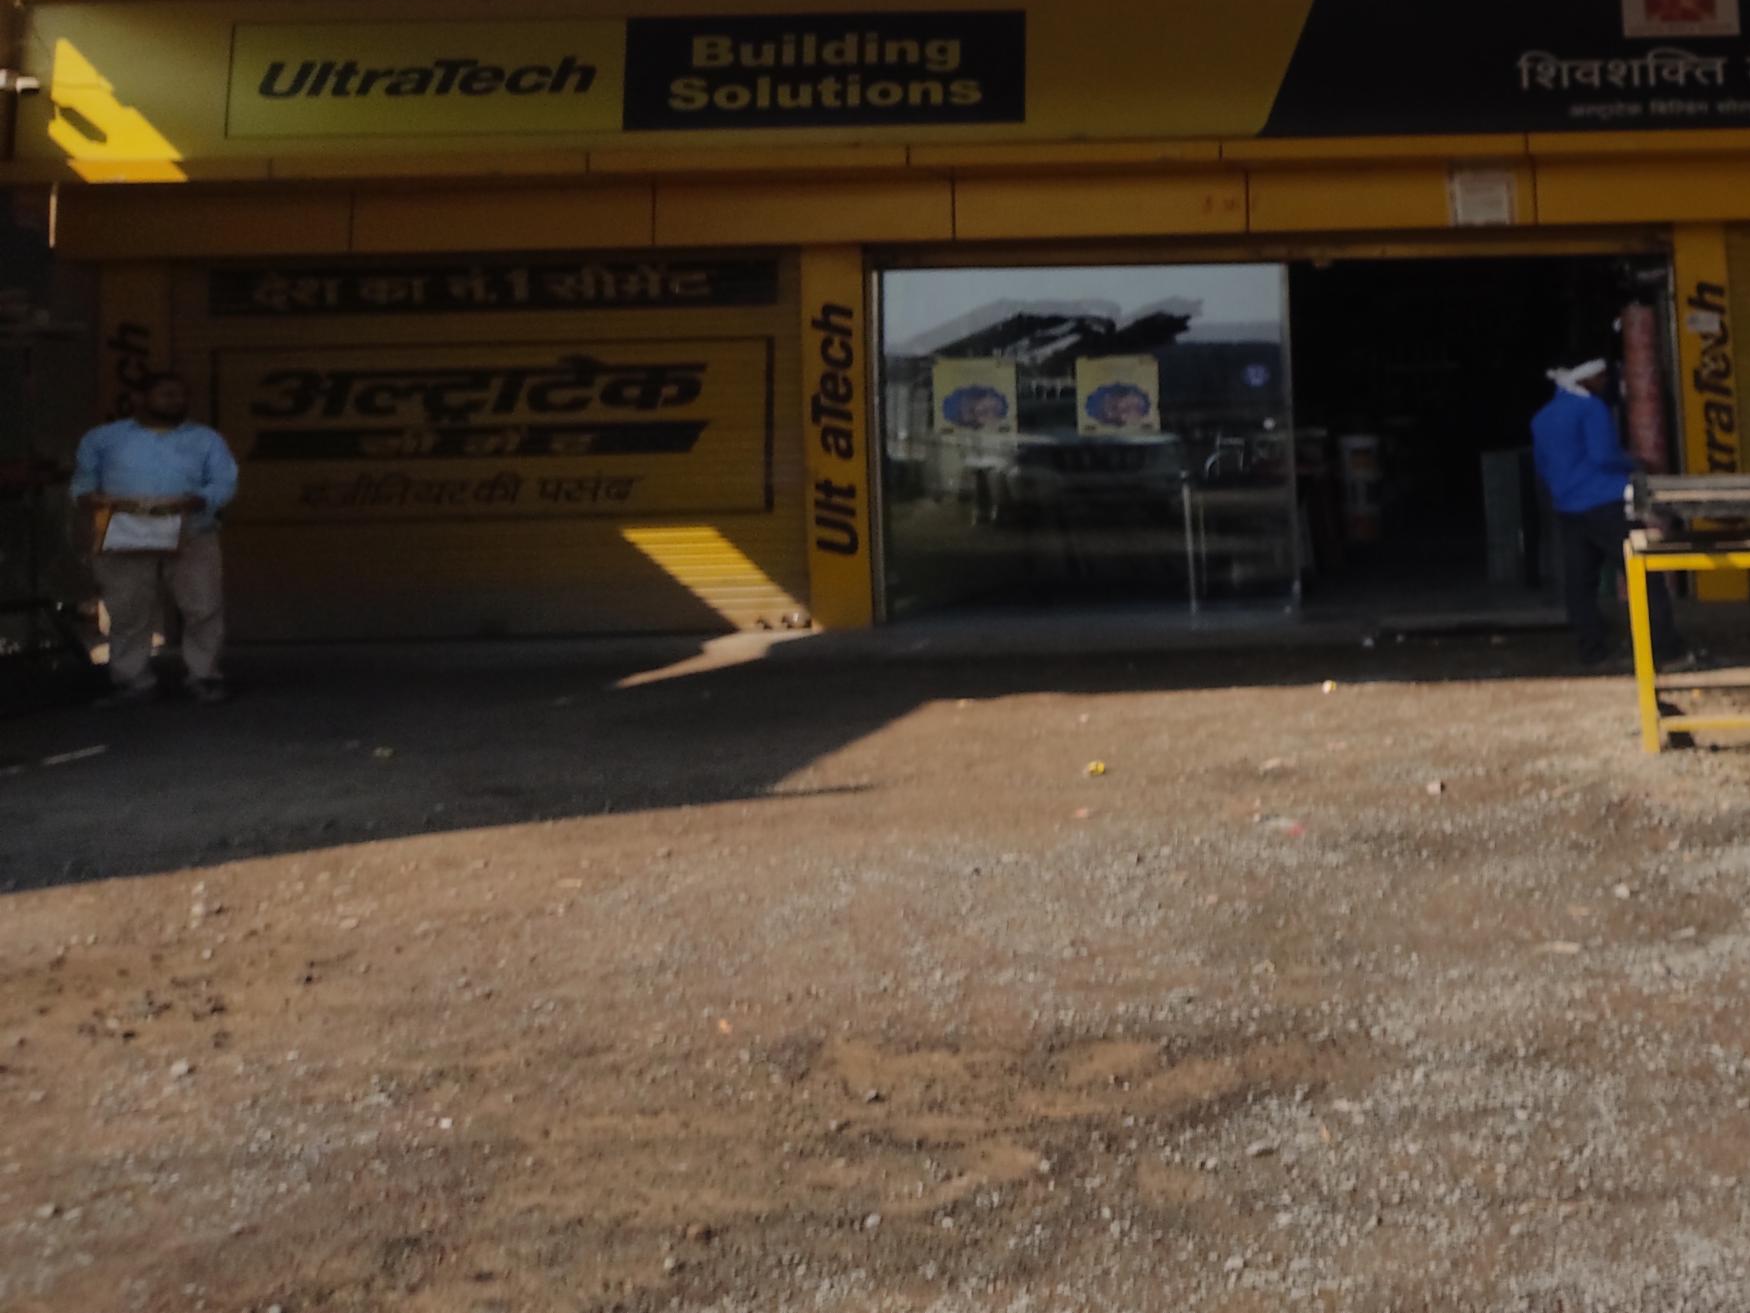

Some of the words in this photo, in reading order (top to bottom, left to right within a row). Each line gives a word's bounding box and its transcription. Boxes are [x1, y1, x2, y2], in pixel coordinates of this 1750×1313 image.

[690, 33, 963, 72] Building
[258, 55, 597, 100] UltraTech
[667, 71, 984, 112] Solutions
